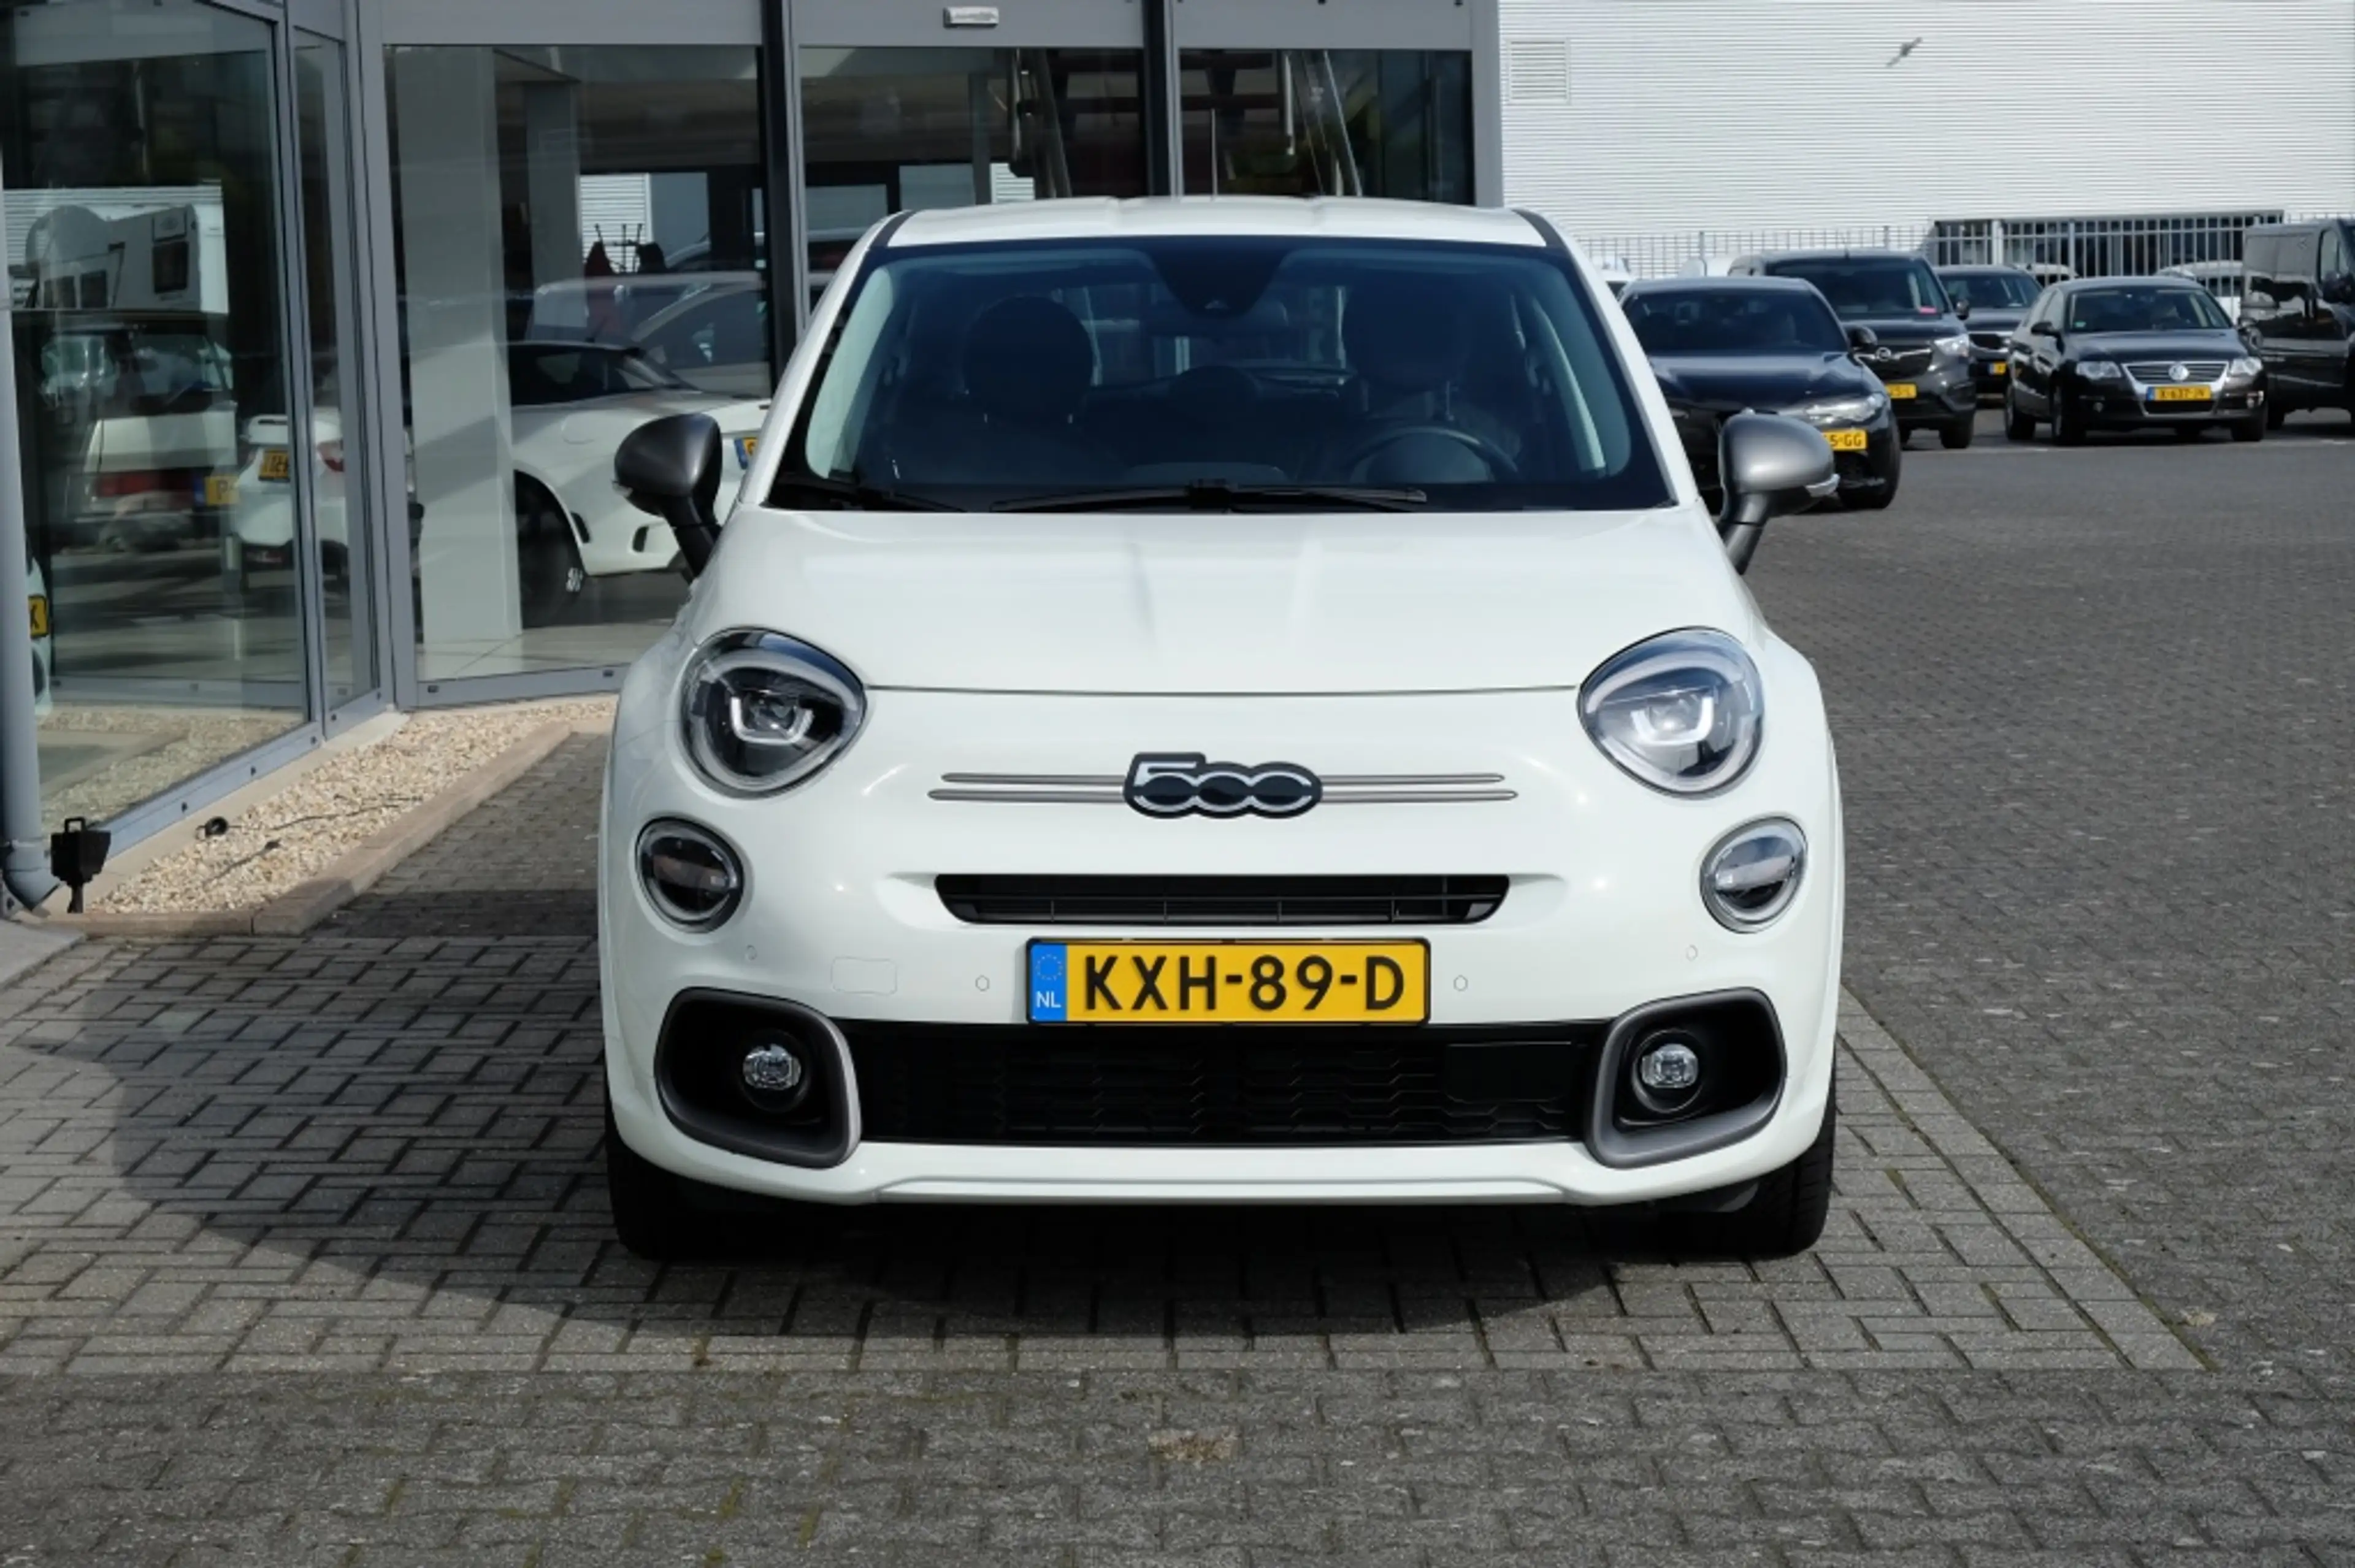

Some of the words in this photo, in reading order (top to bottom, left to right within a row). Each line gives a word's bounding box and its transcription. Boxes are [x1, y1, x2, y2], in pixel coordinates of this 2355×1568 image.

[1823, 433, 1862, 447] 5-GG
[1132, 759, 1314, 813] 500
[1036, 990, 1062, 1009] NL
[1085, 954, 1404, 1011] KXH-89-D
